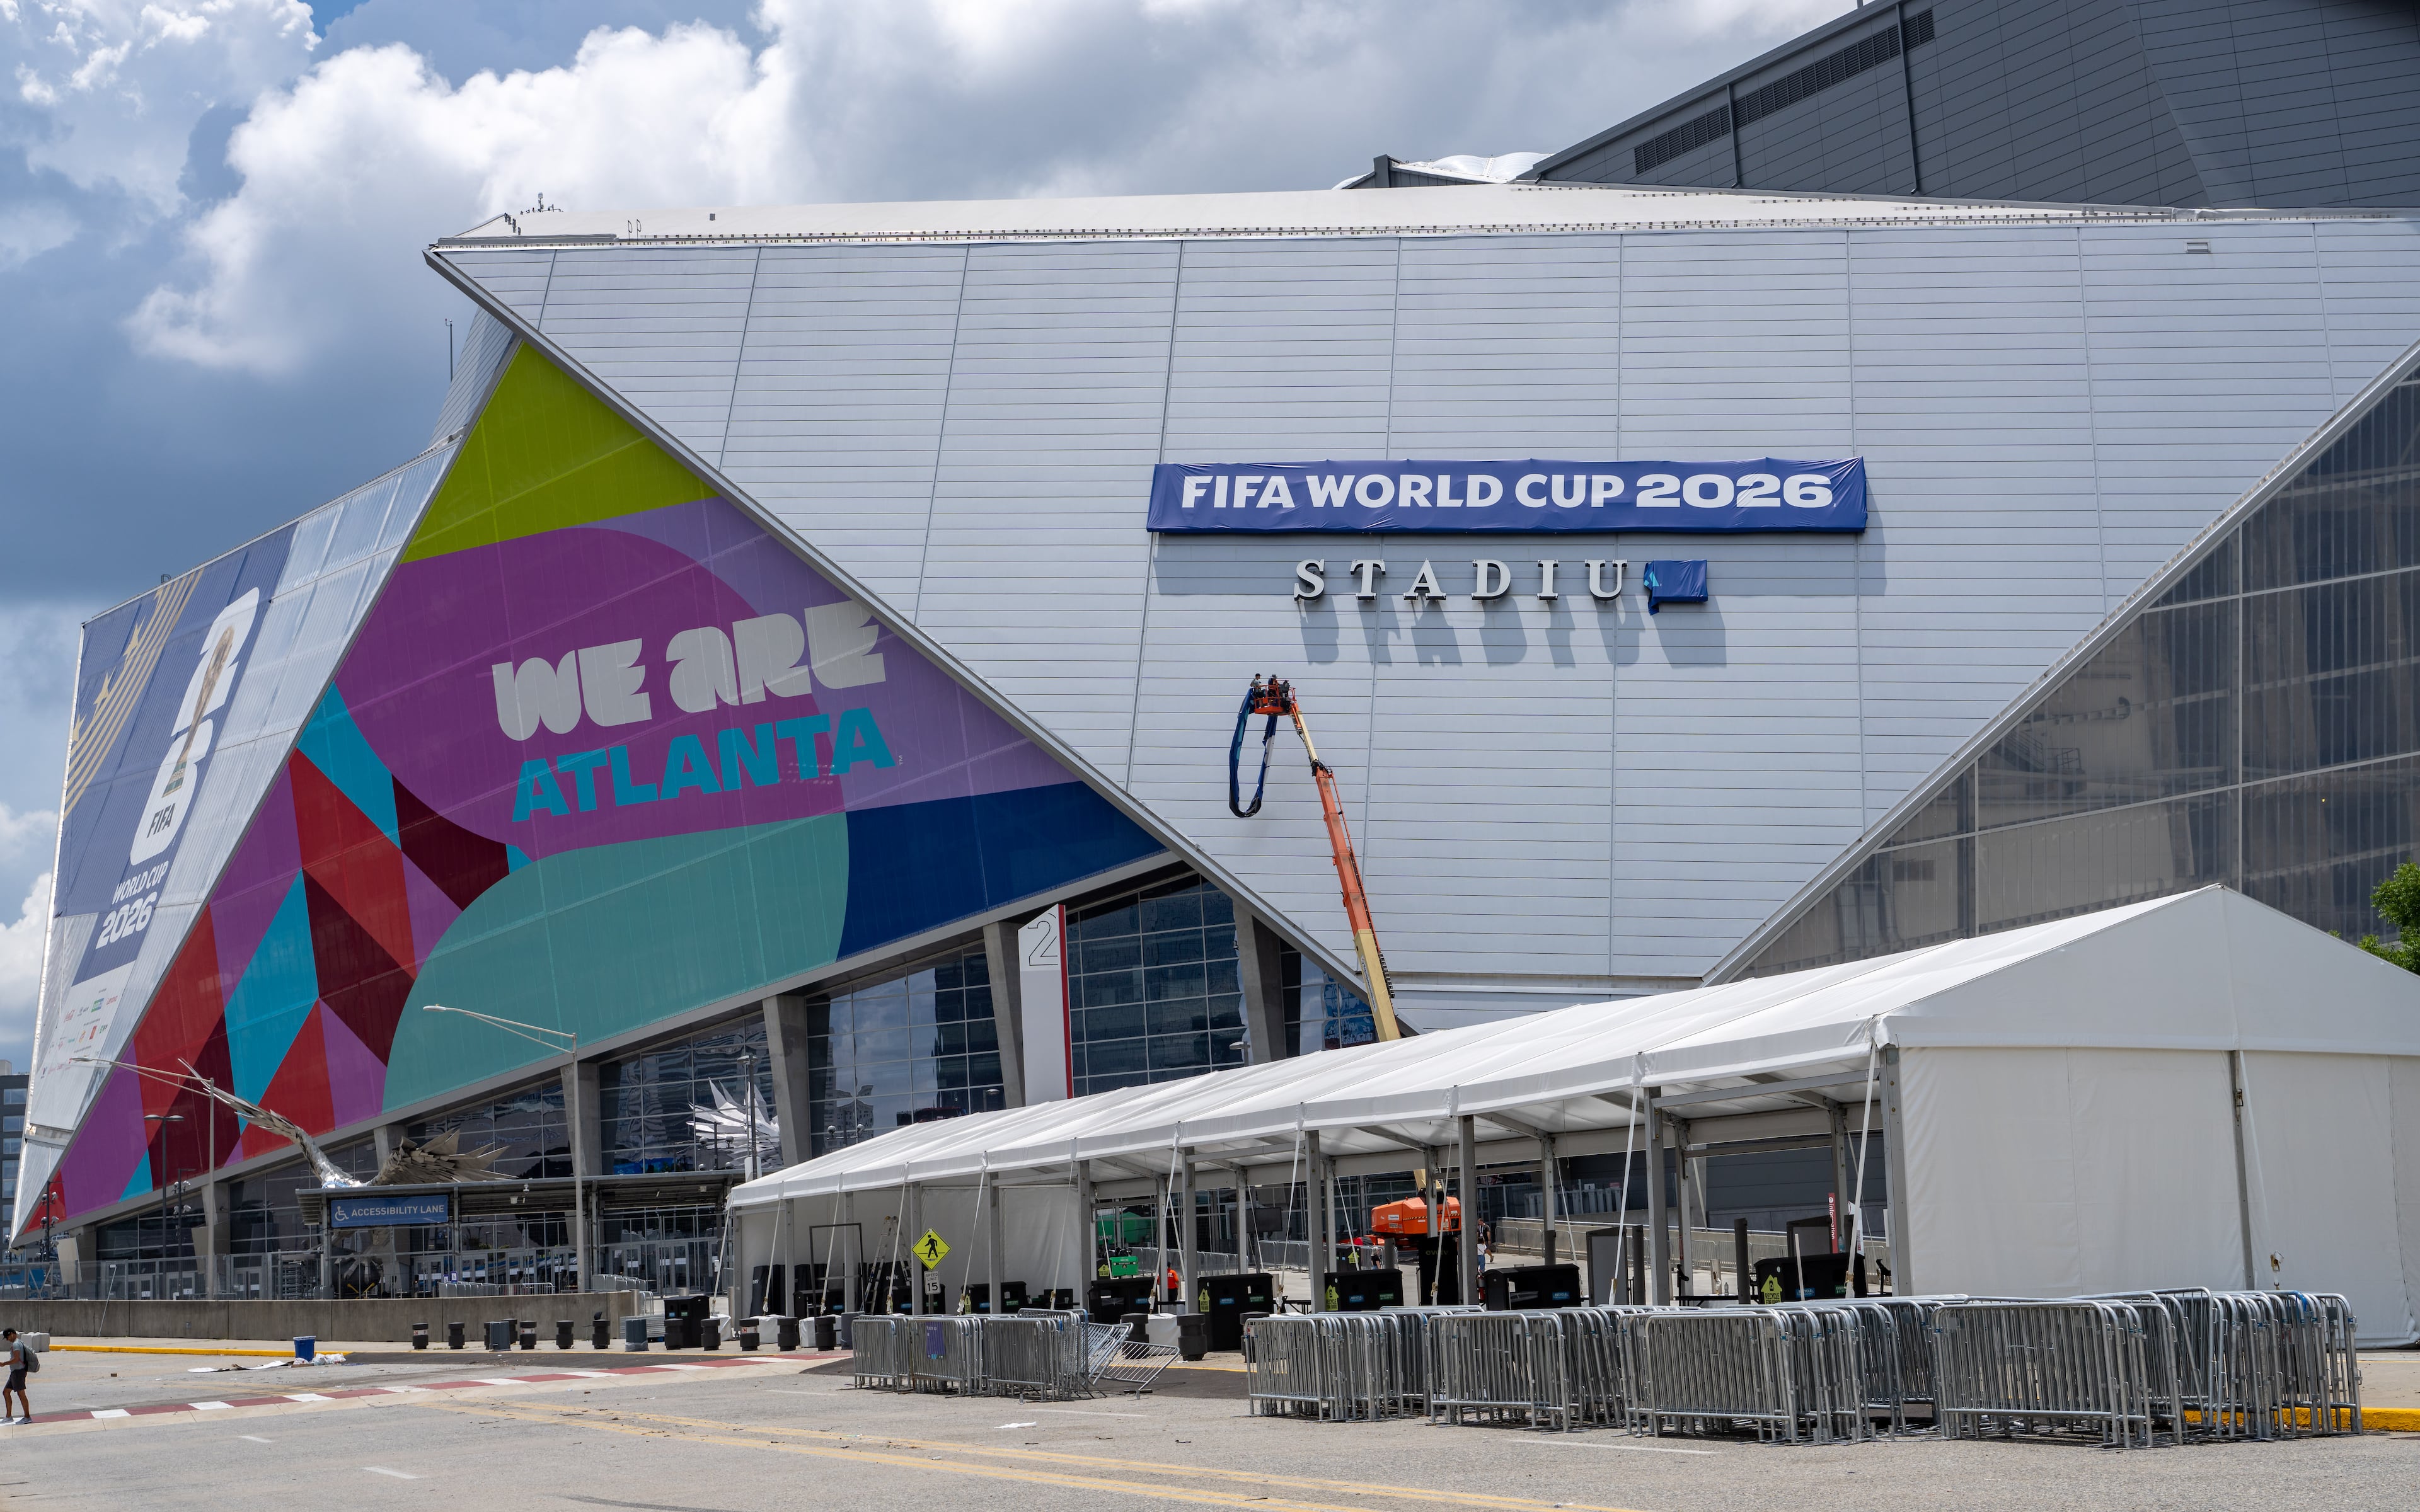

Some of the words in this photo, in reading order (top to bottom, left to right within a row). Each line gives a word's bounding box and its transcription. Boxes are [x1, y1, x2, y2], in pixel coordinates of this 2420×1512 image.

[1182, 475, 1296, 508] FIFA
[1305, 474, 1504, 508] WORLD
[1514, 473, 1625, 508] CUP
[1636, 473, 1833, 508] 2026
[1294, 558, 1628, 601] STADIU
[492, 638, 652, 742] WE
[666, 600, 887, 713] ARE
[512, 707, 896, 823] ATLANTA
[146, 802, 176, 839] FIFA
[112, 870, 149, 905] WORLD
[146, 861, 169, 890] CUP
[95, 891, 158, 950] 2026
[1028, 912, 1059, 966] 2
[351, 1206, 418, 1217] ACCESSIBILITY
[420, 1205, 444, 1213] LANE
[927, 1282, 938, 1292] 15
